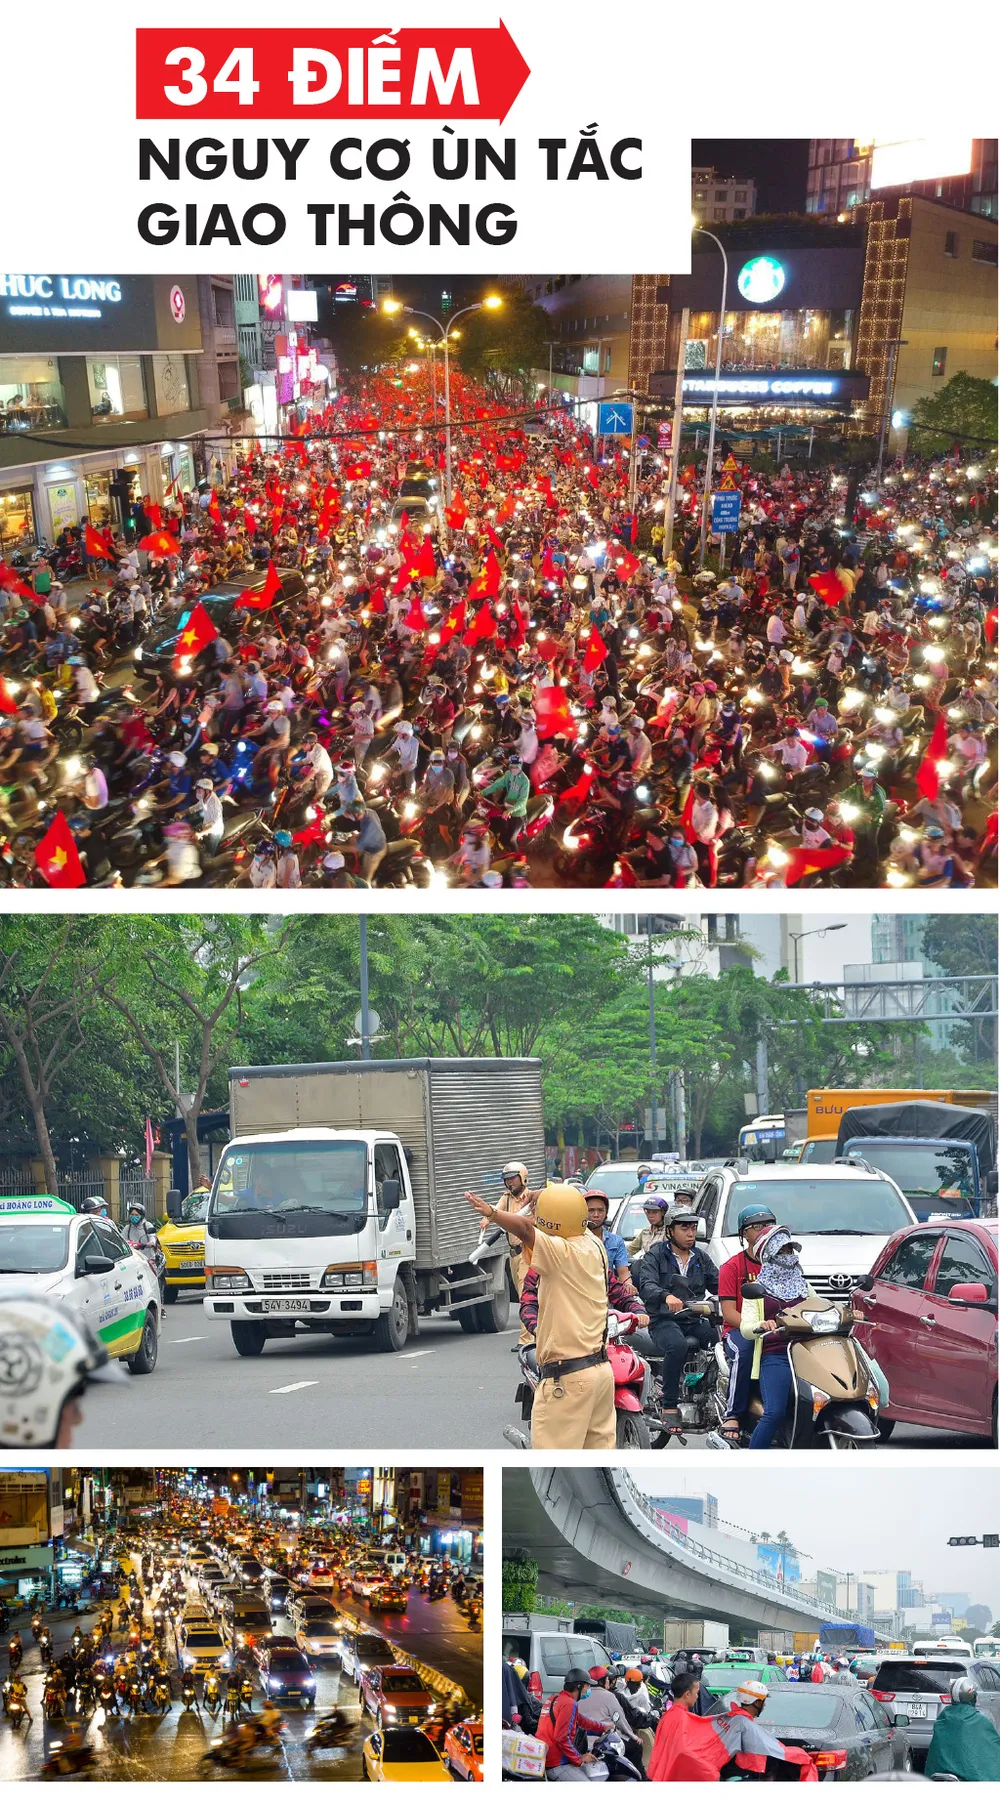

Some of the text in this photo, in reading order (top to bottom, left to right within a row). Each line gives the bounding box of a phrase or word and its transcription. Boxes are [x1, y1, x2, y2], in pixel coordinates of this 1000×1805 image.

[61, 278, 122, 302] LONG
[815, 1104, 843, 1115] BƯU
[6, 1200, 32, 1209] HOÀNG
[33, 1200, 53, 1209] LONG
[261, 1223, 308, 1235] ISUZU
[536, 1216, 562, 1231] CSGT
[264, 1300, 308, 1310] 54V-3494
